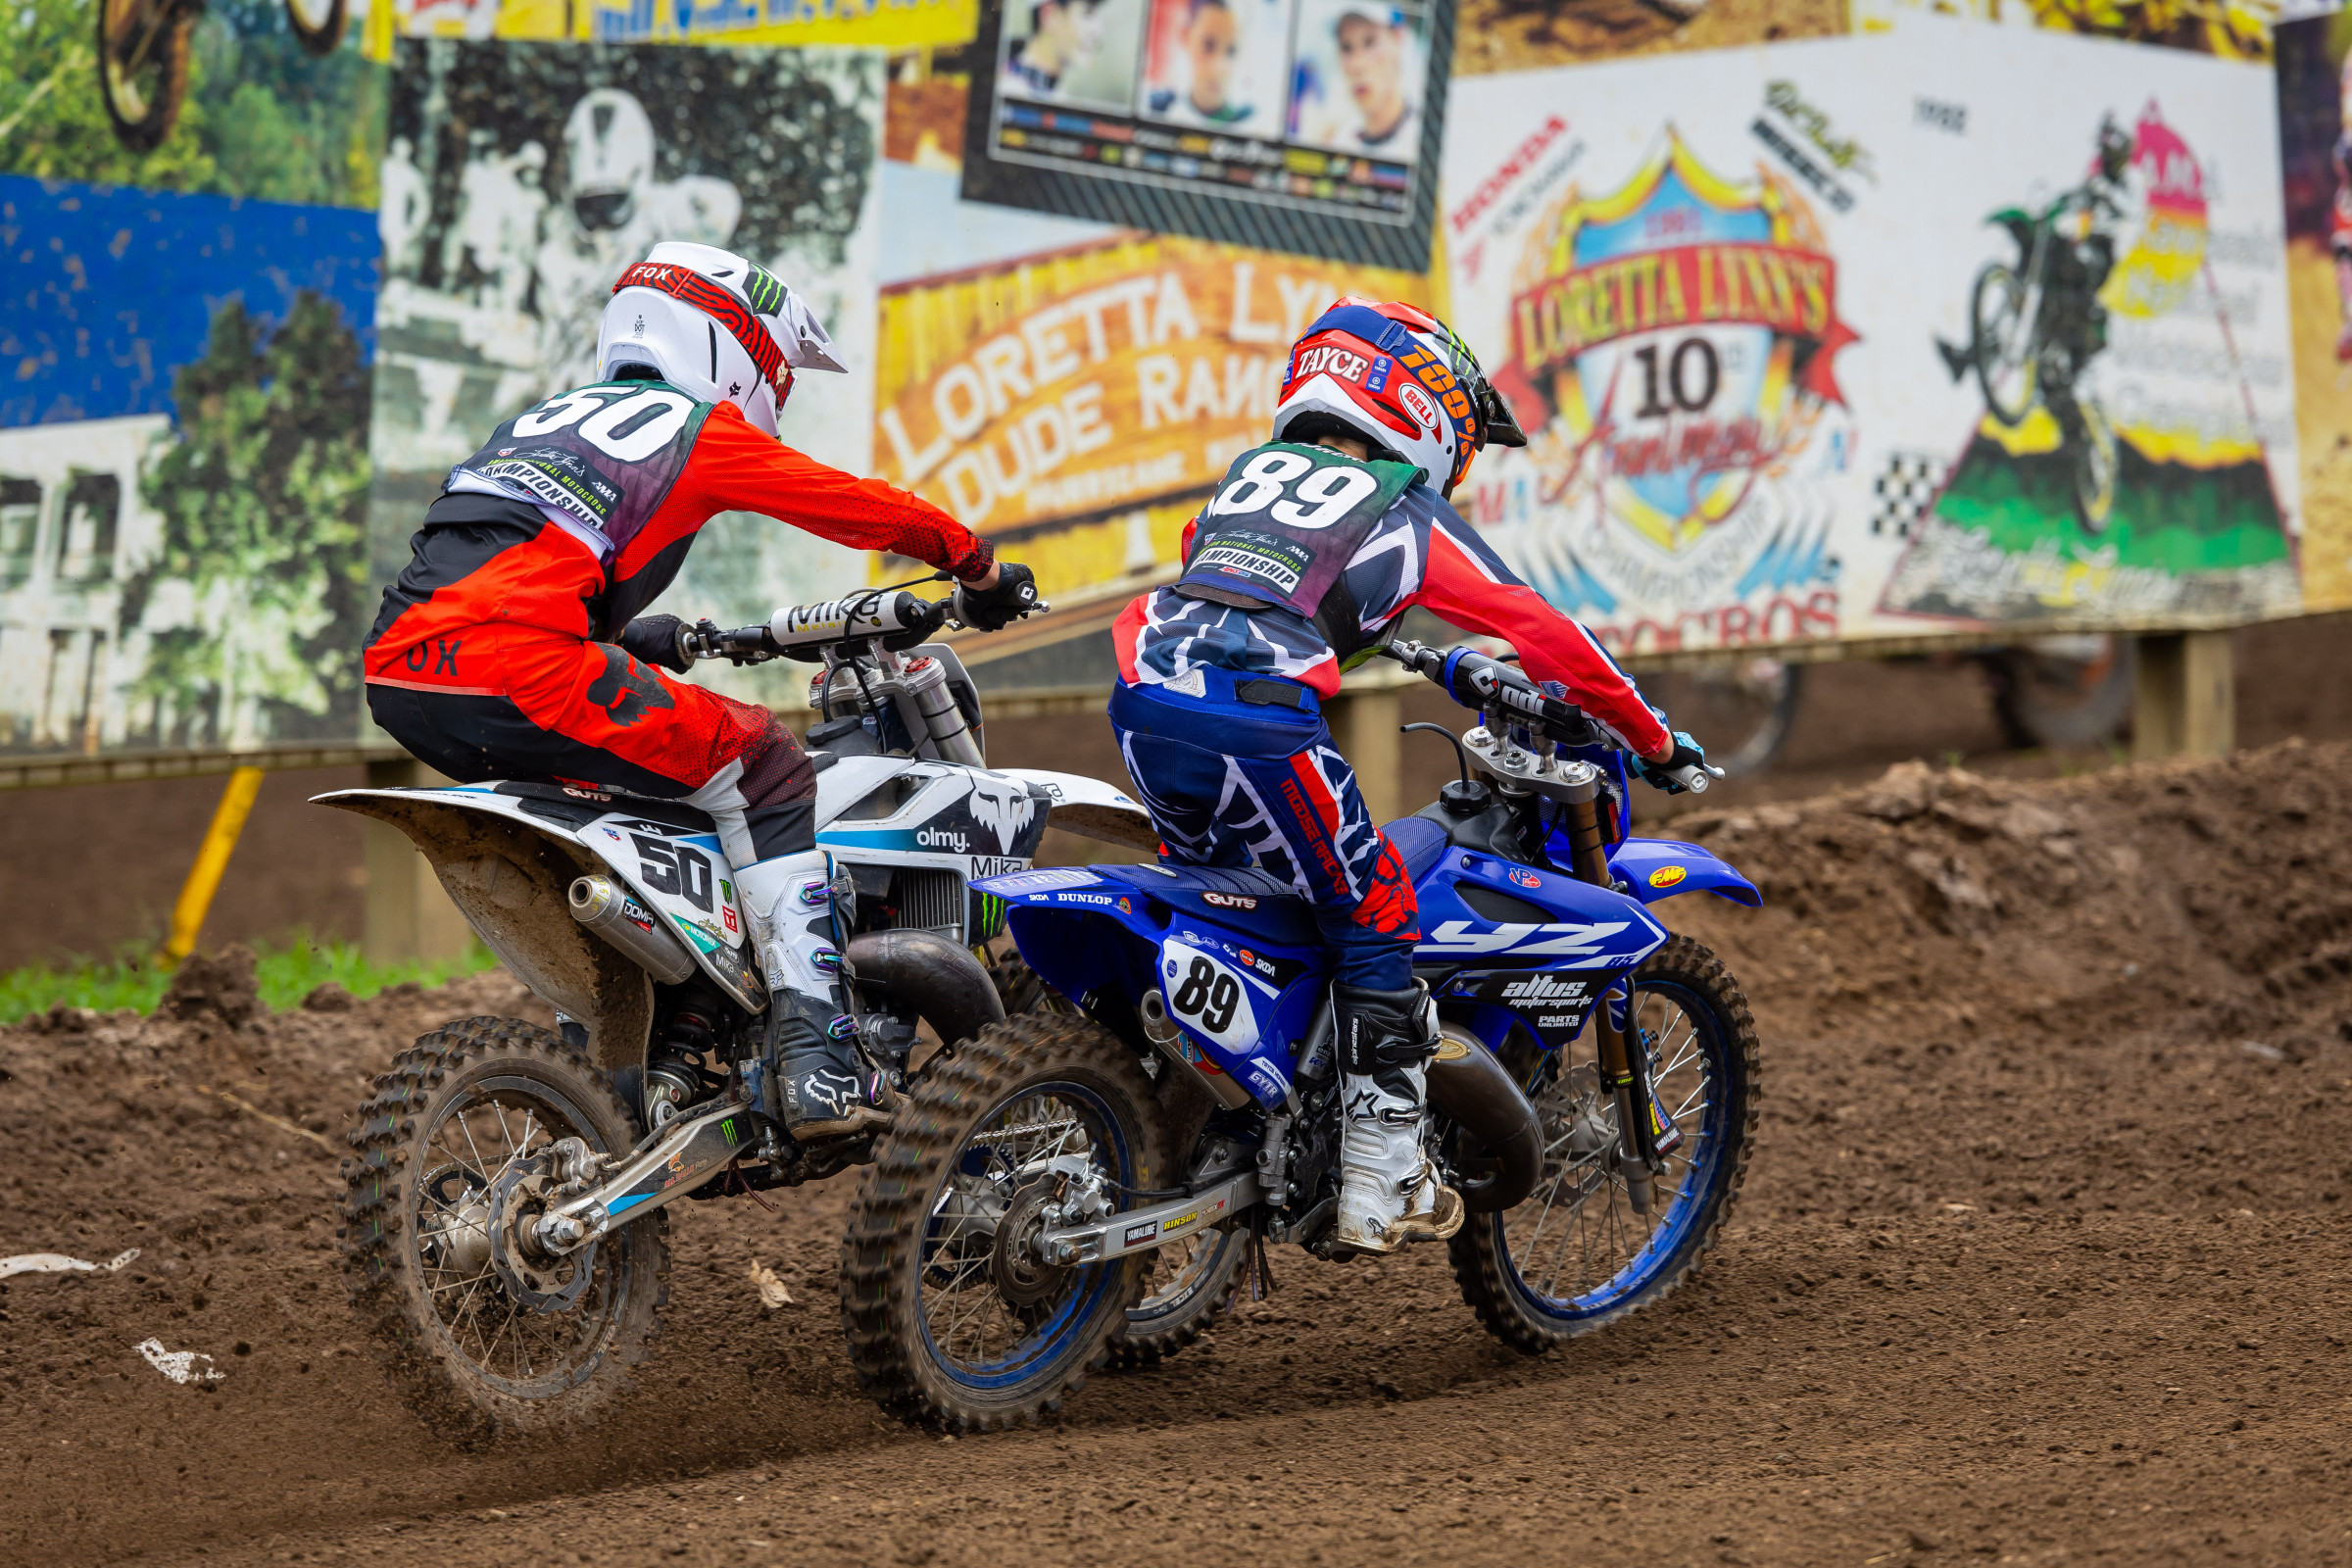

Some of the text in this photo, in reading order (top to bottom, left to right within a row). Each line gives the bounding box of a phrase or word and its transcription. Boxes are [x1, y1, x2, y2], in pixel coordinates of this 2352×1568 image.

[1451, 110, 1571, 233] HONDA
[632, 266, 672, 281] FOX
[1517, 252, 1688, 374] LORETTA
[878, 270, 1201, 482] LORETTA
[1295, 346, 1370, 383] TAYCE
[1634, 336, 1720, 419] 10
[1398, 344, 1476, 458] 100%
[1403, 388, 1435, 424] BELL
[512, 385, 696, 463] 50
[937, 350, 1288, 525] DUDE RANC
[1211, 450, 1378, 529] 89
[1200, 549, 1296, 585] AMPIONSHIP
[1221, 540, 1256, 551] NATIONAL
[1256, 547, 1302, 572] MOTOCROSS
[796, 619, 848, 633] Metal
[406, 640, 463, 677] OX
[562, 786, 612, 803] GUTS
[916, 826, 971, 854] olmy.
[1279, 777, 1350, 896] MOOSE RACING
[628, 832, 714, 914] 50
[971, 856, 1023, 880] Mika
[1649, 866, 1686, 887] FMF
[623, 902, 655, 926] DOMA
[1056, 893, 1113, 906] DUNLOP
[1202, 892, 1258, 910] GUTS
[689, 925, 717, 949] MOTOREX
[1412, 919, 1632, 956] YZ
[1172, 955, 1241, 1034] 89
[1500, 973, 1588, 999] altus
[1508, 995, 1593, 1010] motorsports
[1539, 1014, 1580, 1023] PARTS
[1349, 1017, 1359, 1065] alpinestars
[787, 1078, 798, 1103] FOX
[1248, 1070, 1279, 1099] GYTR
[1127, 1223, 1156, 1243] YAMALUBE
[1163, 1211, 1199, 1230] HINSON
